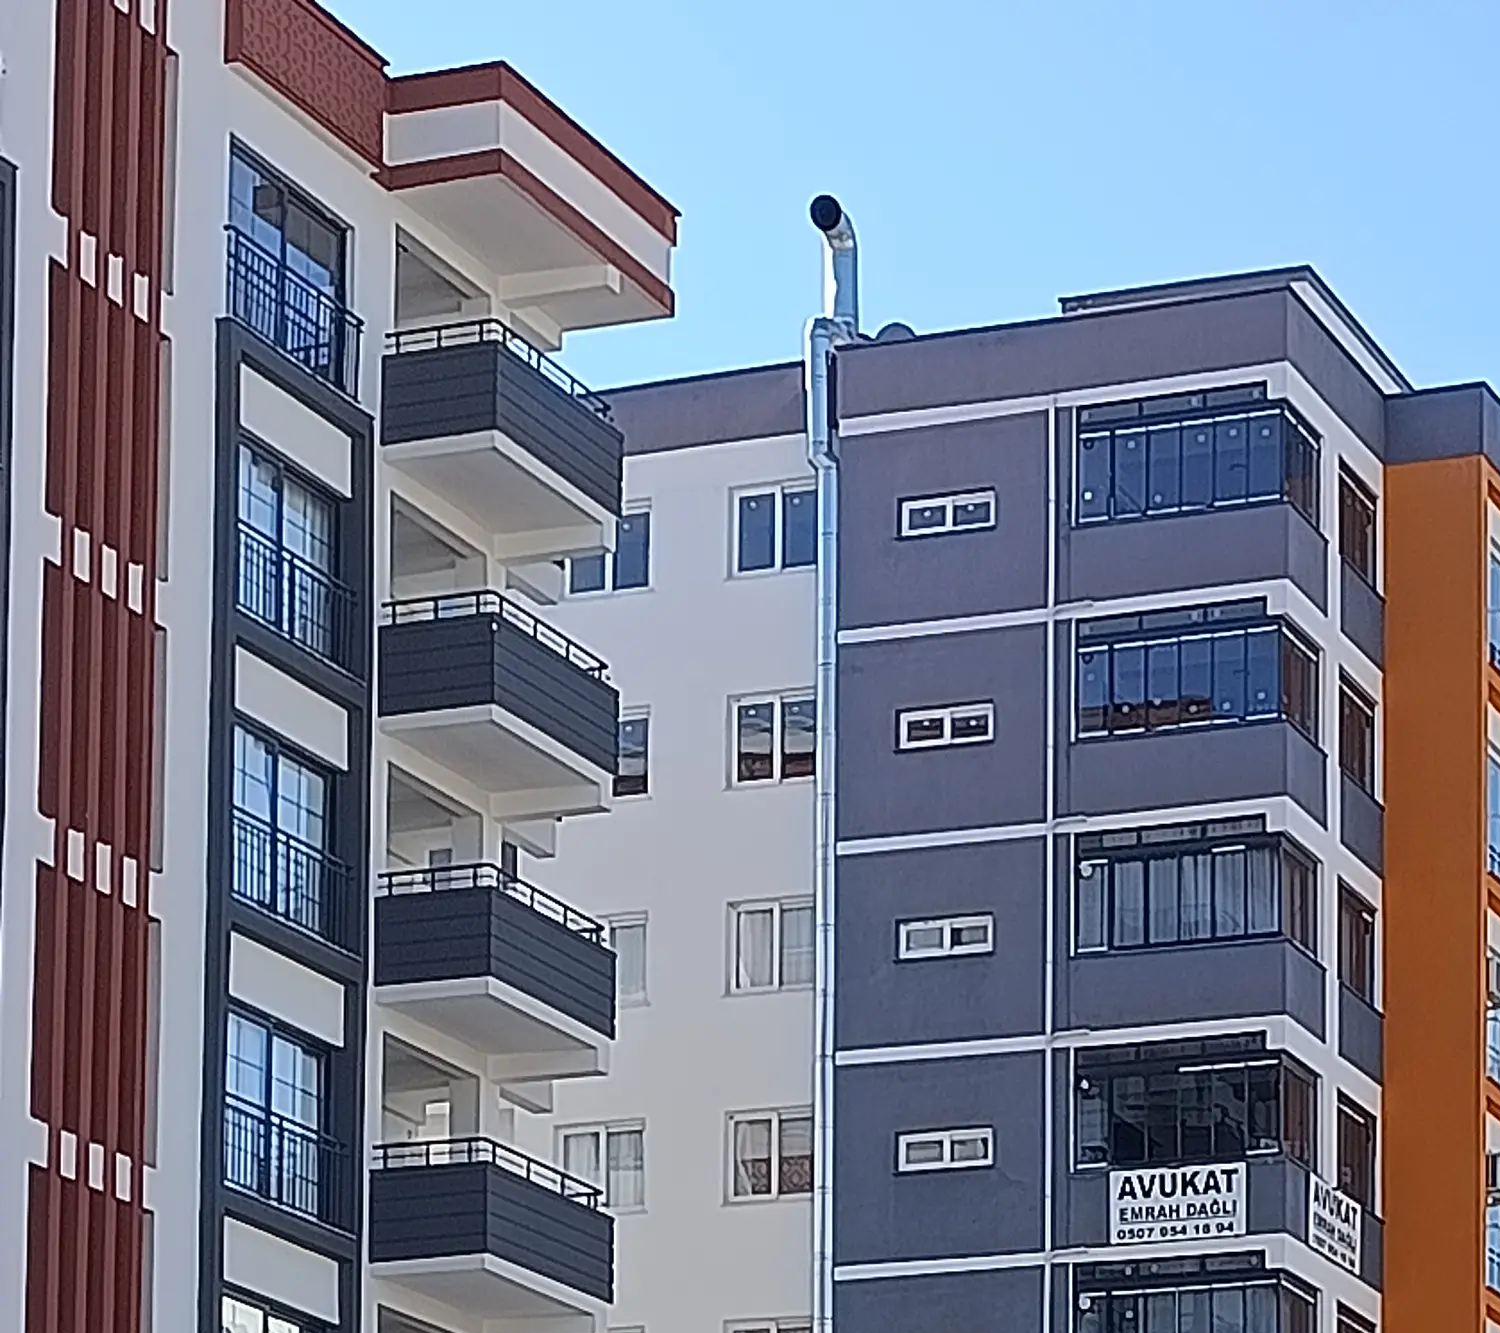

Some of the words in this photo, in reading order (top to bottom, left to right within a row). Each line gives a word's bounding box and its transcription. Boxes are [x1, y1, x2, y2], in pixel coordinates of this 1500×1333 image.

[1117, 1168, 1239, 1200] AVUKAT
[1119, 1204, 1180, 1222] EMRAH
[1186, 1198, 1237, 1218] DAĞLI
[1313, 1180, 1358, 1231] AVUKAT
[1117, 1227, 1155, 1240] 0507
